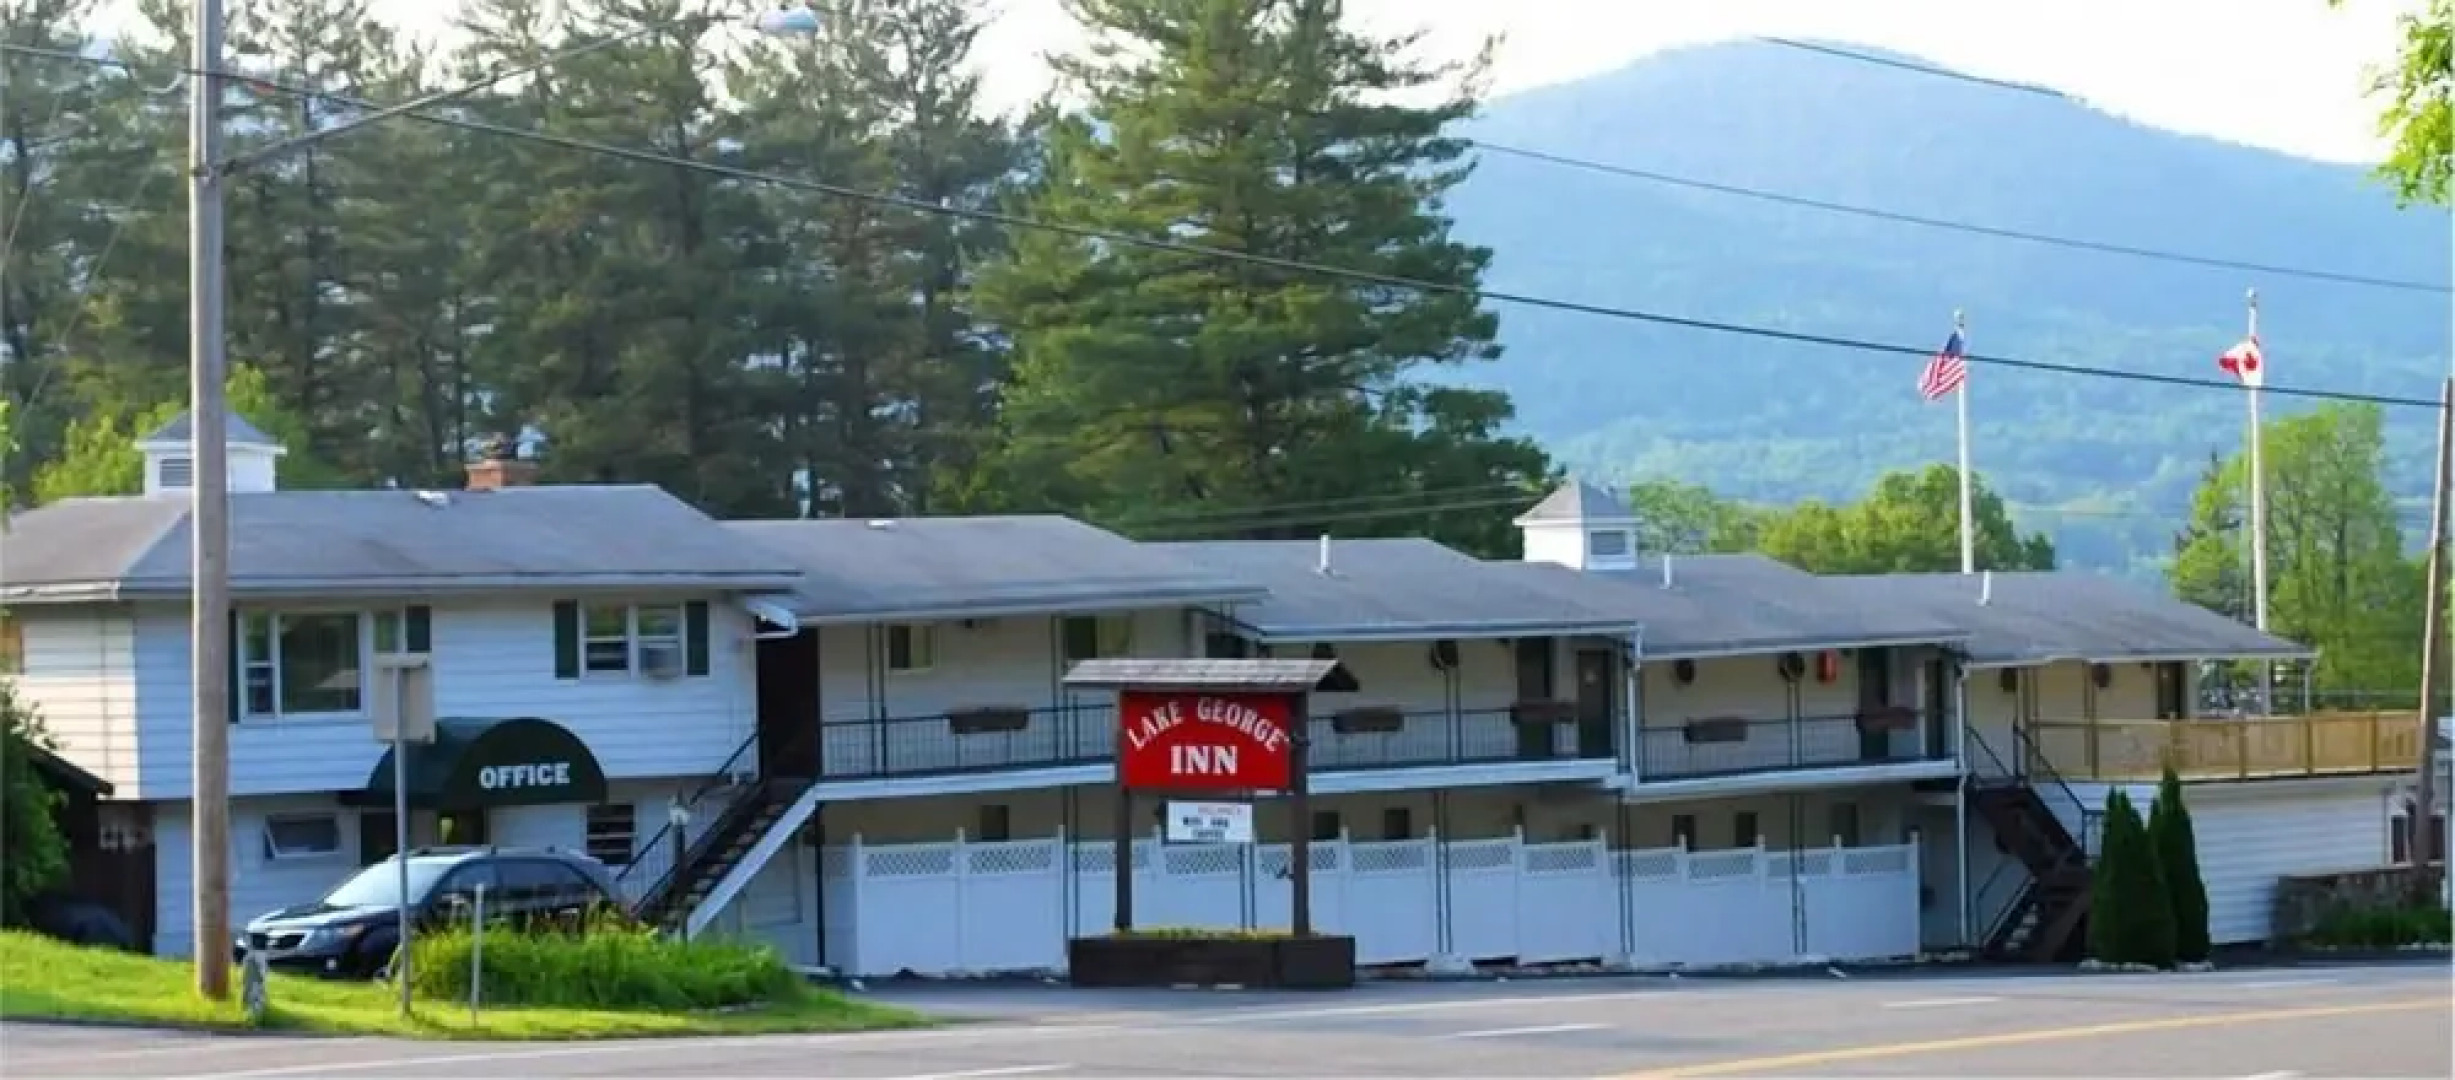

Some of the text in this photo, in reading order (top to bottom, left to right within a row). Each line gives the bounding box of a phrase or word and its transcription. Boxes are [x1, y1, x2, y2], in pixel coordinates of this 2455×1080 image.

[1127, 697, 1289, 752] LAKE GEORGE
[1171, 745, 1238, 775] INN
[480, 762, 570, 790] OFFICE
